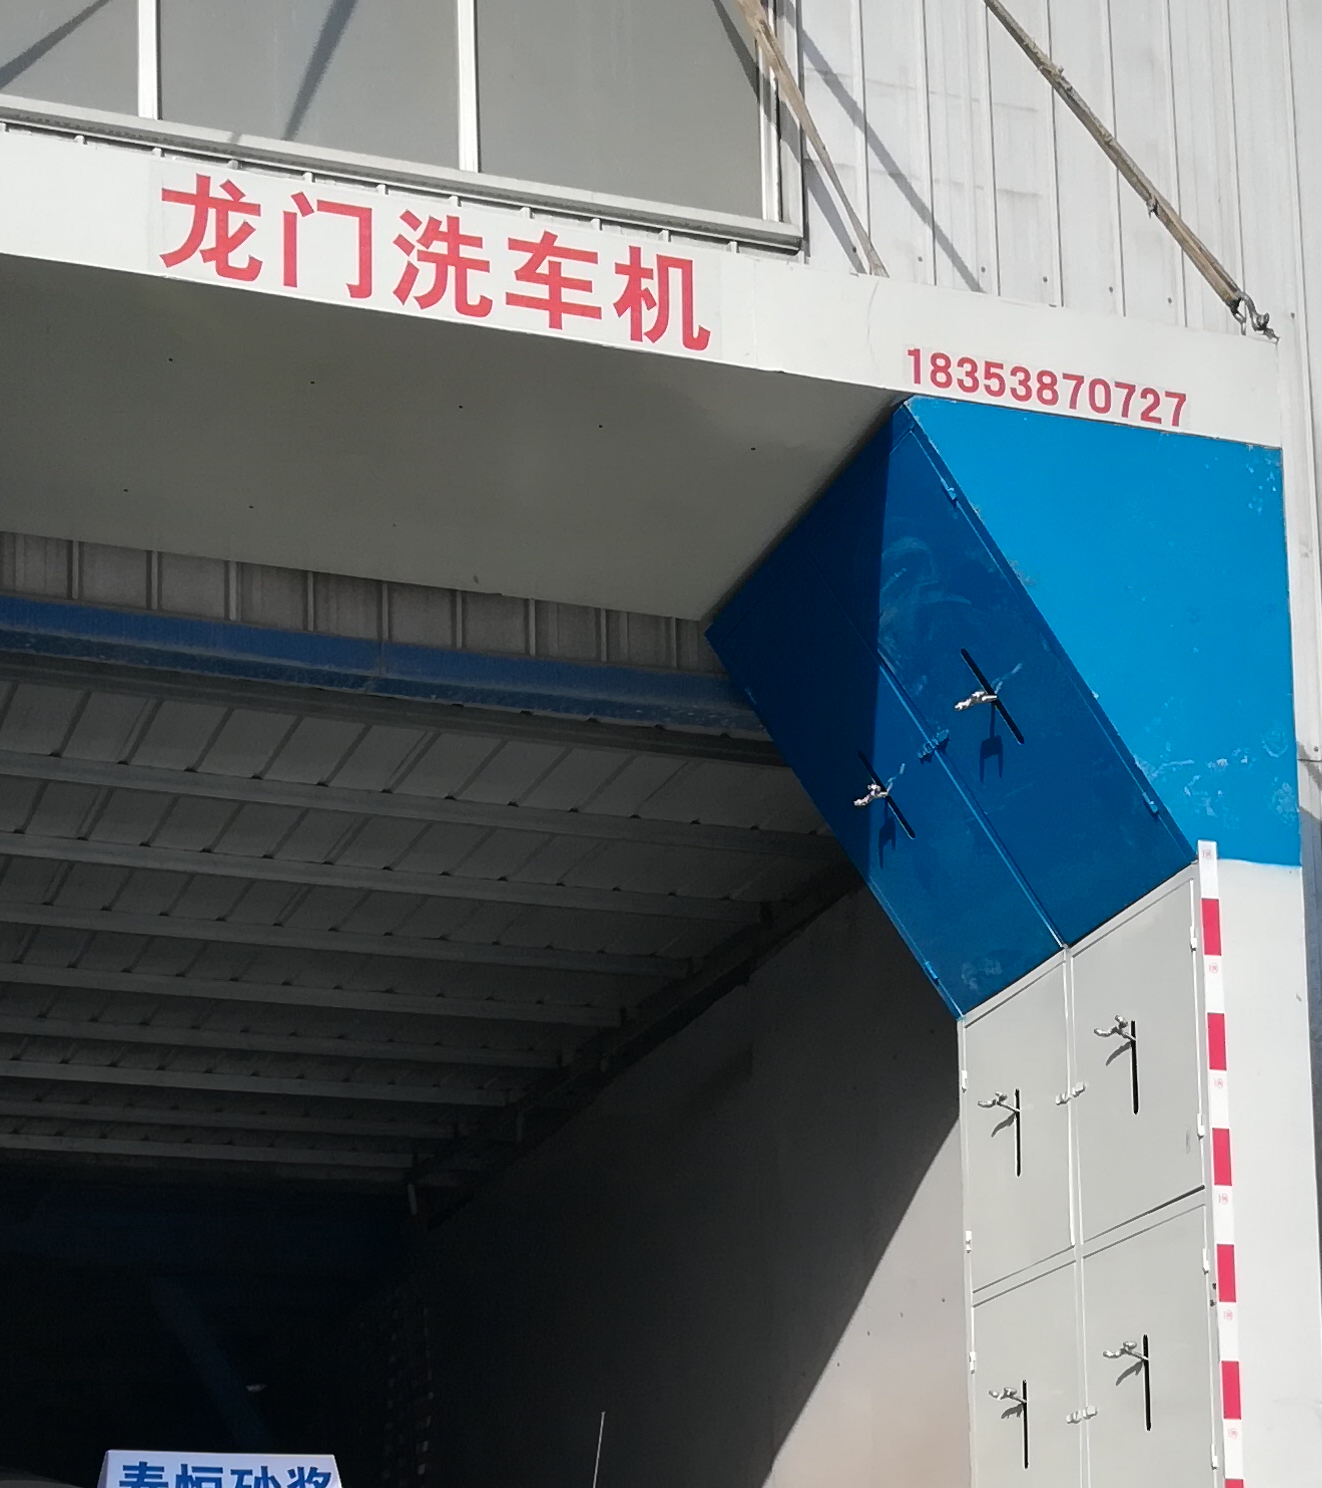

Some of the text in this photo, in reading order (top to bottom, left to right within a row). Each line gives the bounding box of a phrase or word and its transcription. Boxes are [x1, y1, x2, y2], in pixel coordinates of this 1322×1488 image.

[161, 174, 711, 352] 龙门洗车机
[906, 347, 1187, 428] 18353870727
